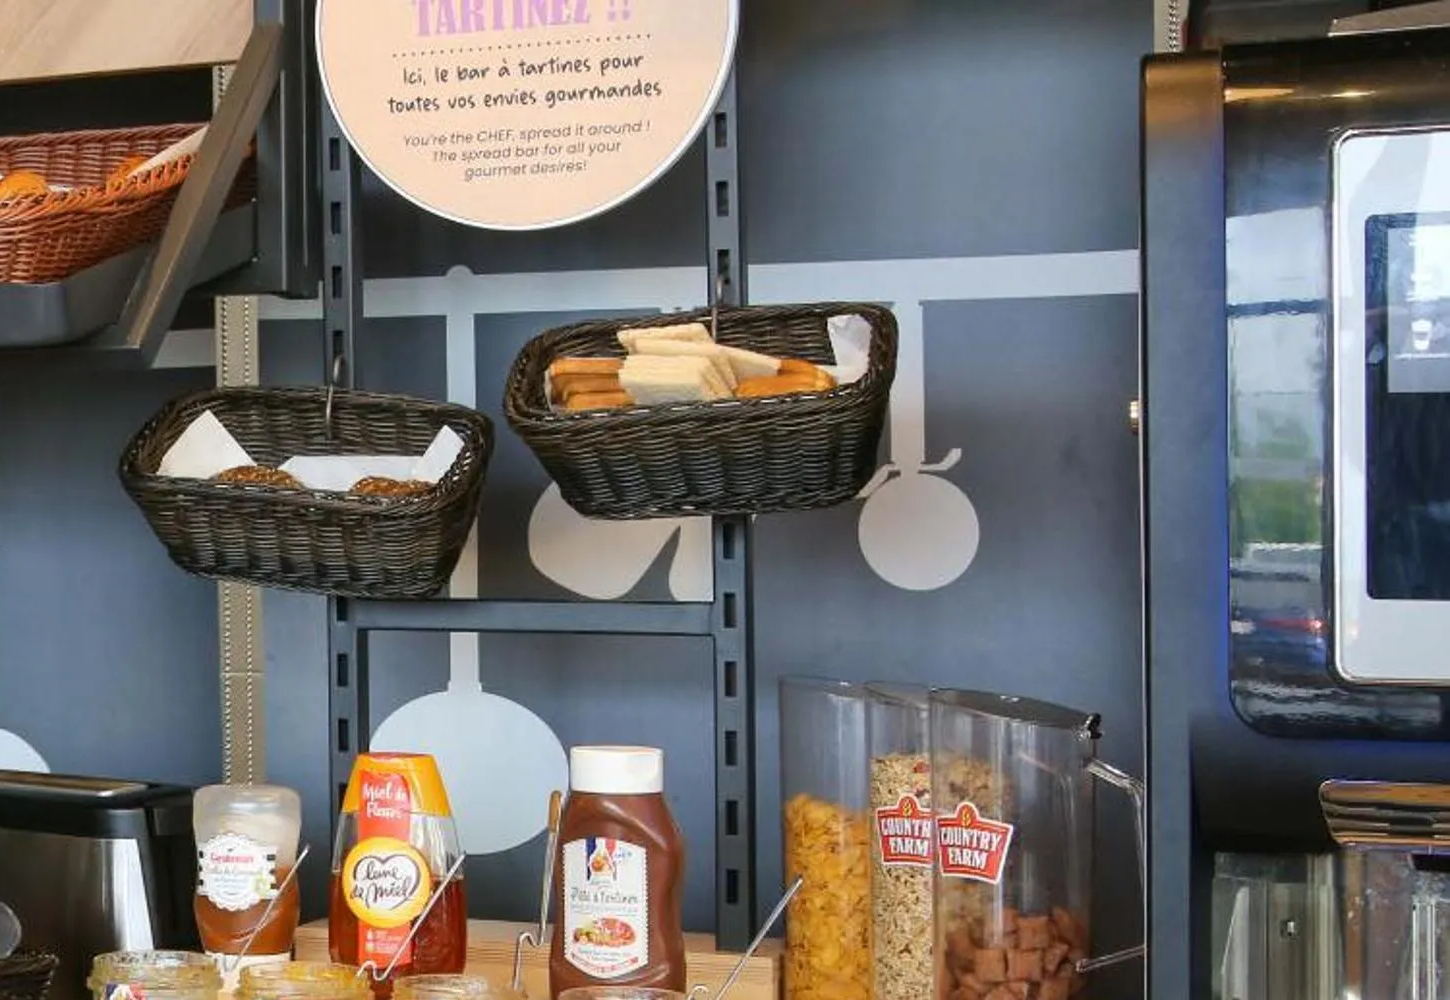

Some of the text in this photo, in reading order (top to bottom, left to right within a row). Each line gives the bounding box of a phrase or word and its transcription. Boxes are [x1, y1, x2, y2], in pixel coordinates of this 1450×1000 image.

[411, 0, 590, 37] TARTINEZ
[403, 55, 644, 86] Ici, le bar à tartines pour
[387, 79, 662, 113] toutes vos envies gourmandes
[403, 133, 448, 147] You're
[450, 131, 474, 144] the
[477, 128, 515, 142] CHEF,
[519, 125, 571, 143] spread
[575, 122, 583, 136] it
[587, 119, 642, 136] around
[433, 141, 621, 163] The spread bar for all your
[464, 158, 587, 182] gourmet desires!
[880, 818, 931, 838] COUNTR
[941, 827, 1002, 852] COUNTRY
[889, 836, 930, 857] FARM
[948, 848, 988, 870] FARM
